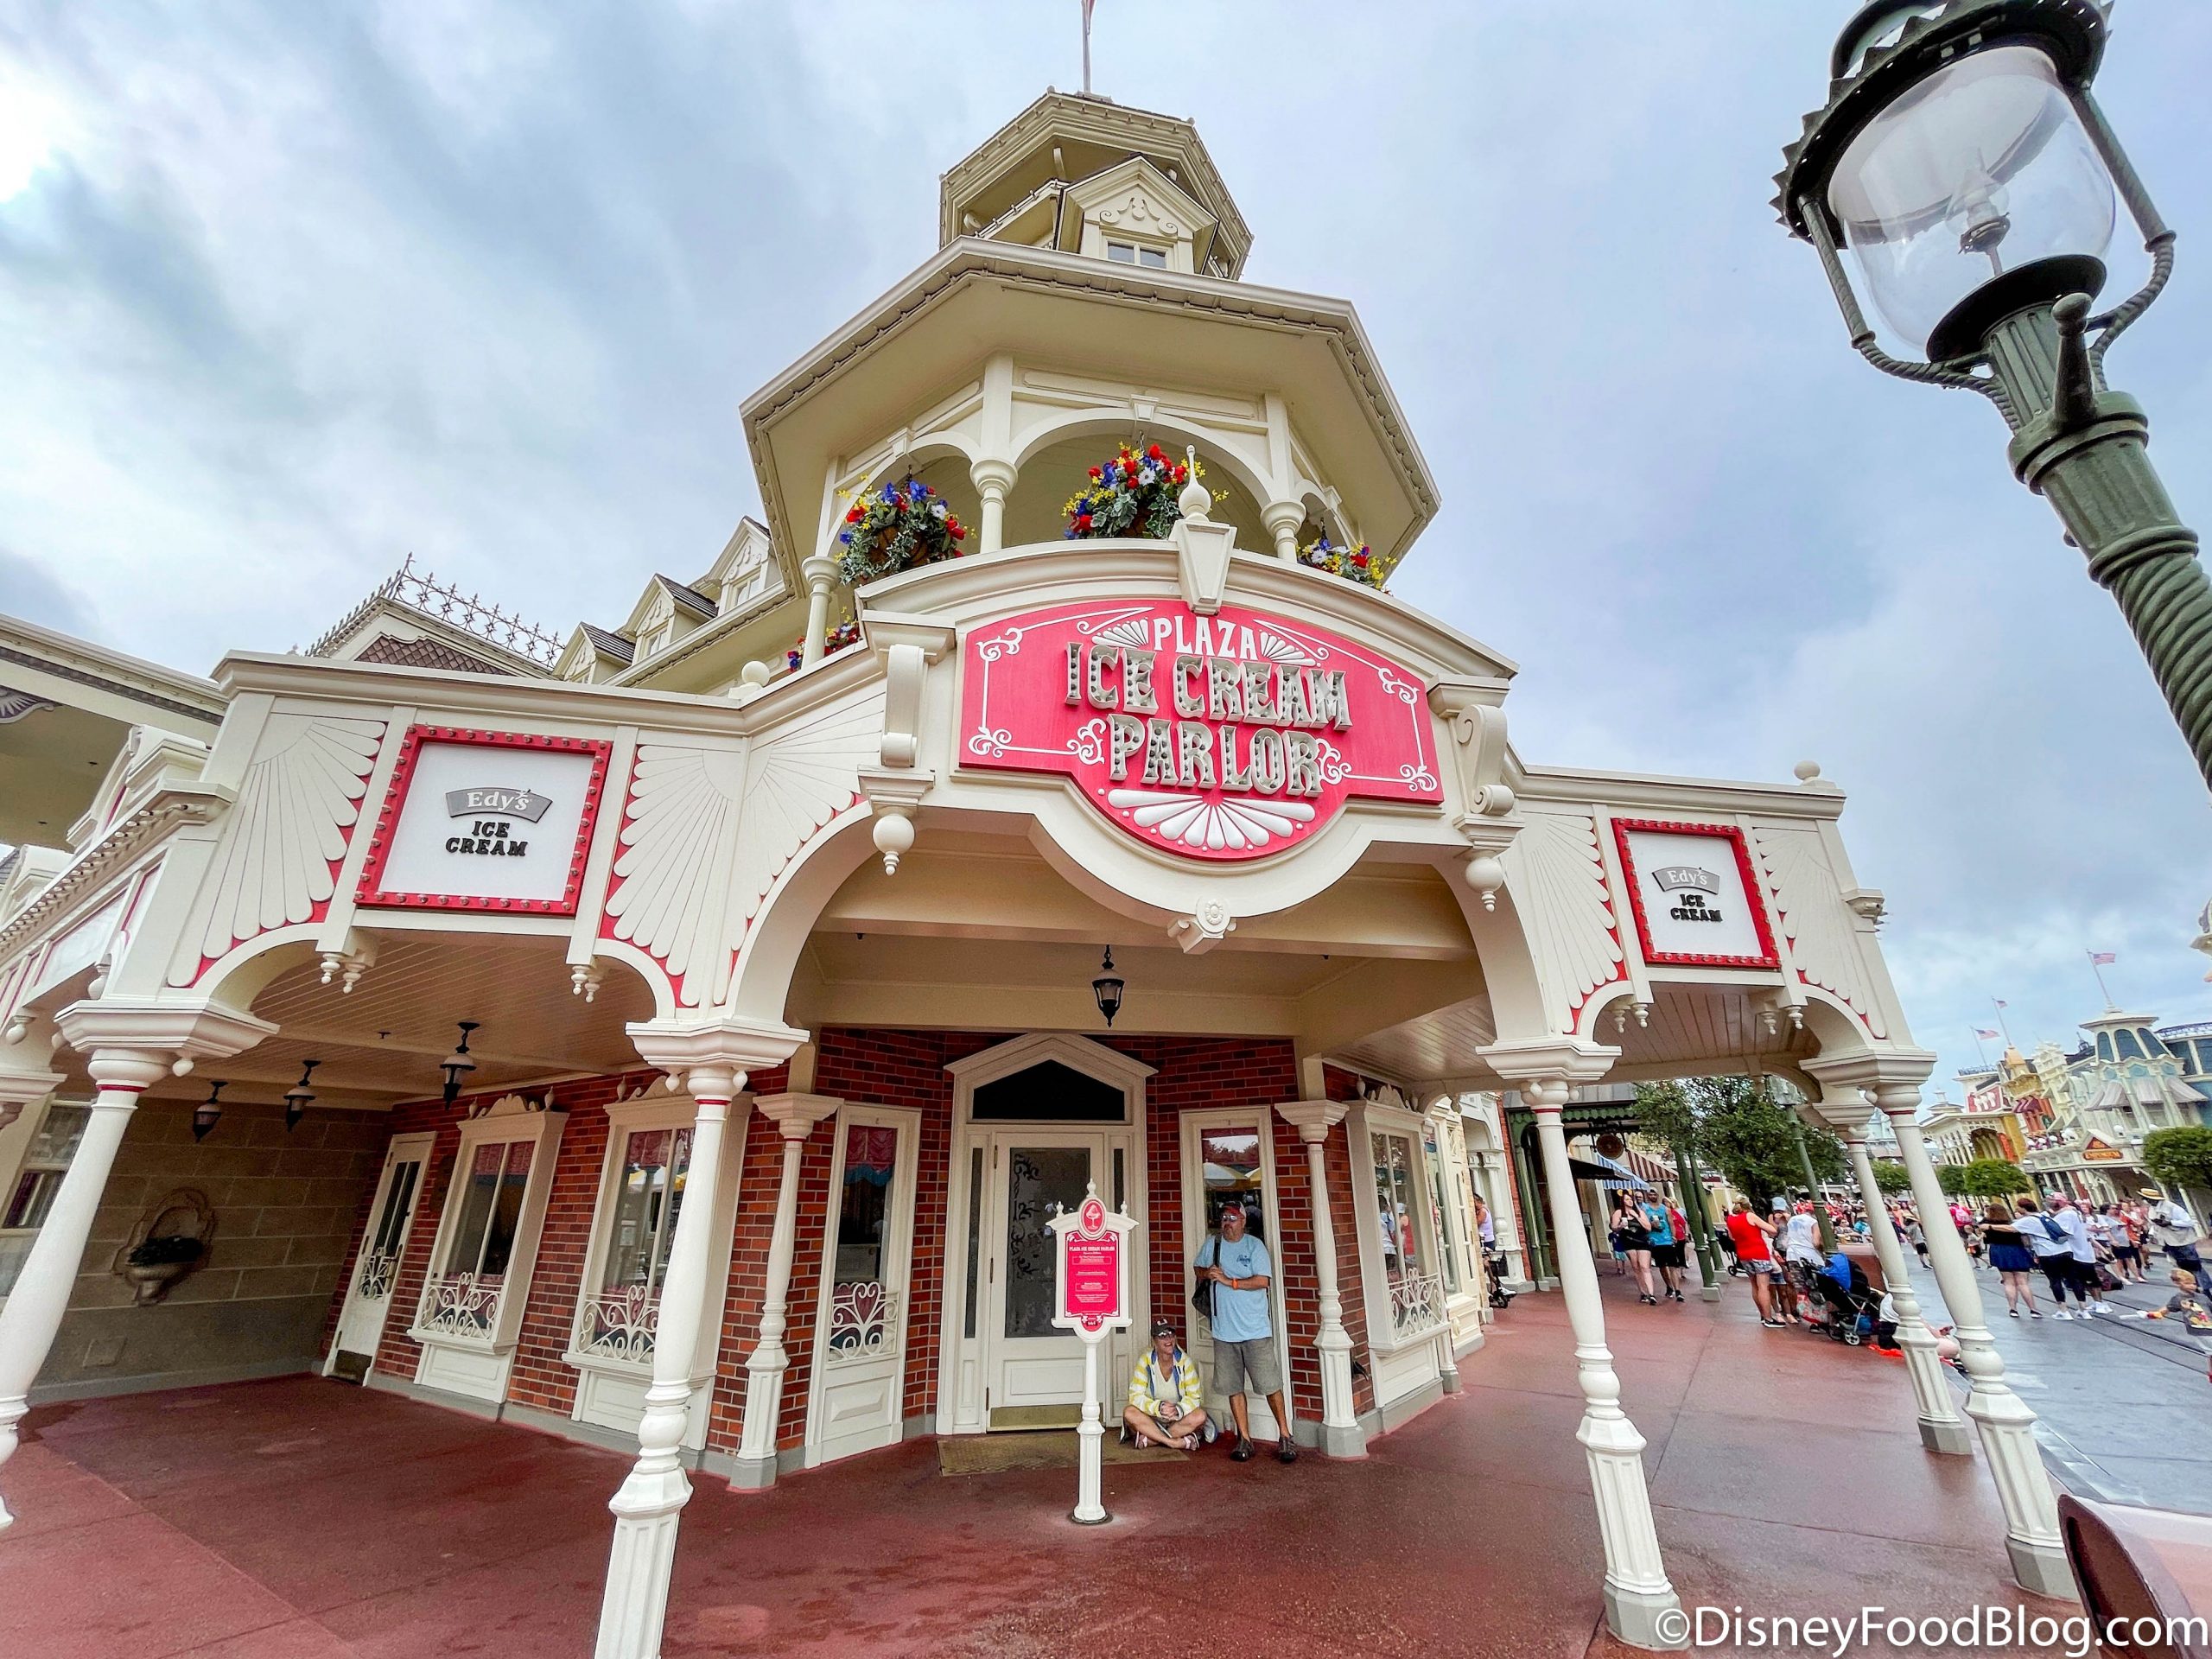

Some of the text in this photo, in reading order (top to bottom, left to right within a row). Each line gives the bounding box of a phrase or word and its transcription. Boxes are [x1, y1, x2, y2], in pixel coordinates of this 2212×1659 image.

[1153, 616, 1258, 659] PLAZA
[1065, 643, 1353, 731] ICE CREAM
[1108, 714, 1324, 797] PARLOR
[467, 790, 530, 811] Edy's
[472, 821, 511, 838] ICE
[445, 837, 528, 857] CREAM
[1667, 868, 1707, 886] Edy's
[1680, 894, 1706, 908] ICE
[1670, 908, 1723, 923] CREAM
